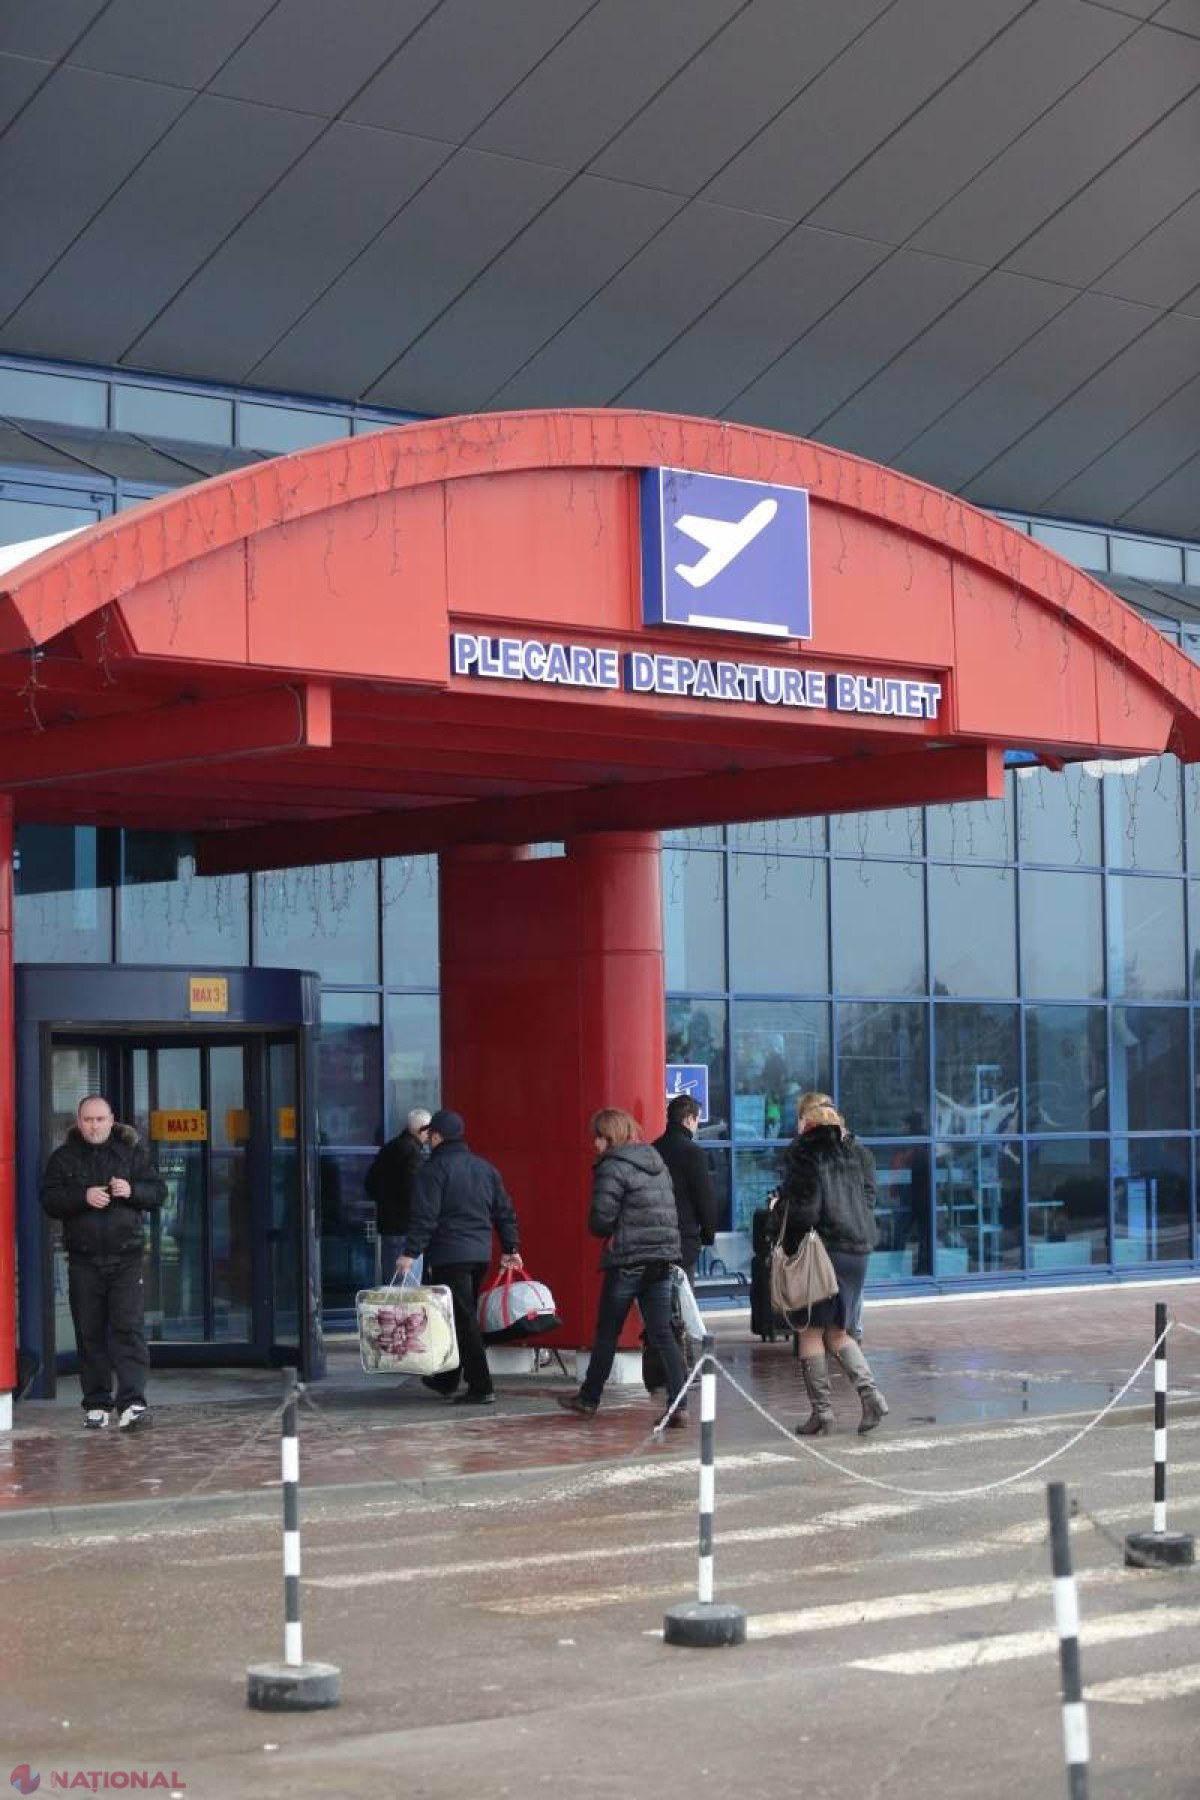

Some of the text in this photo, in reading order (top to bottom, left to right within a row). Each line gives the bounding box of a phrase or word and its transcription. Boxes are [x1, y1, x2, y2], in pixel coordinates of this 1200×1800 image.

[453, 633, 826, 707] PLECARE DEPARTURE
[837, 673, 942, 720] ВЫЛЕТ
[191, 987, 212, 1003] MAX
[167, 1119, 190, 1132] MAX
[191, 1118, 198, 1132] 3
